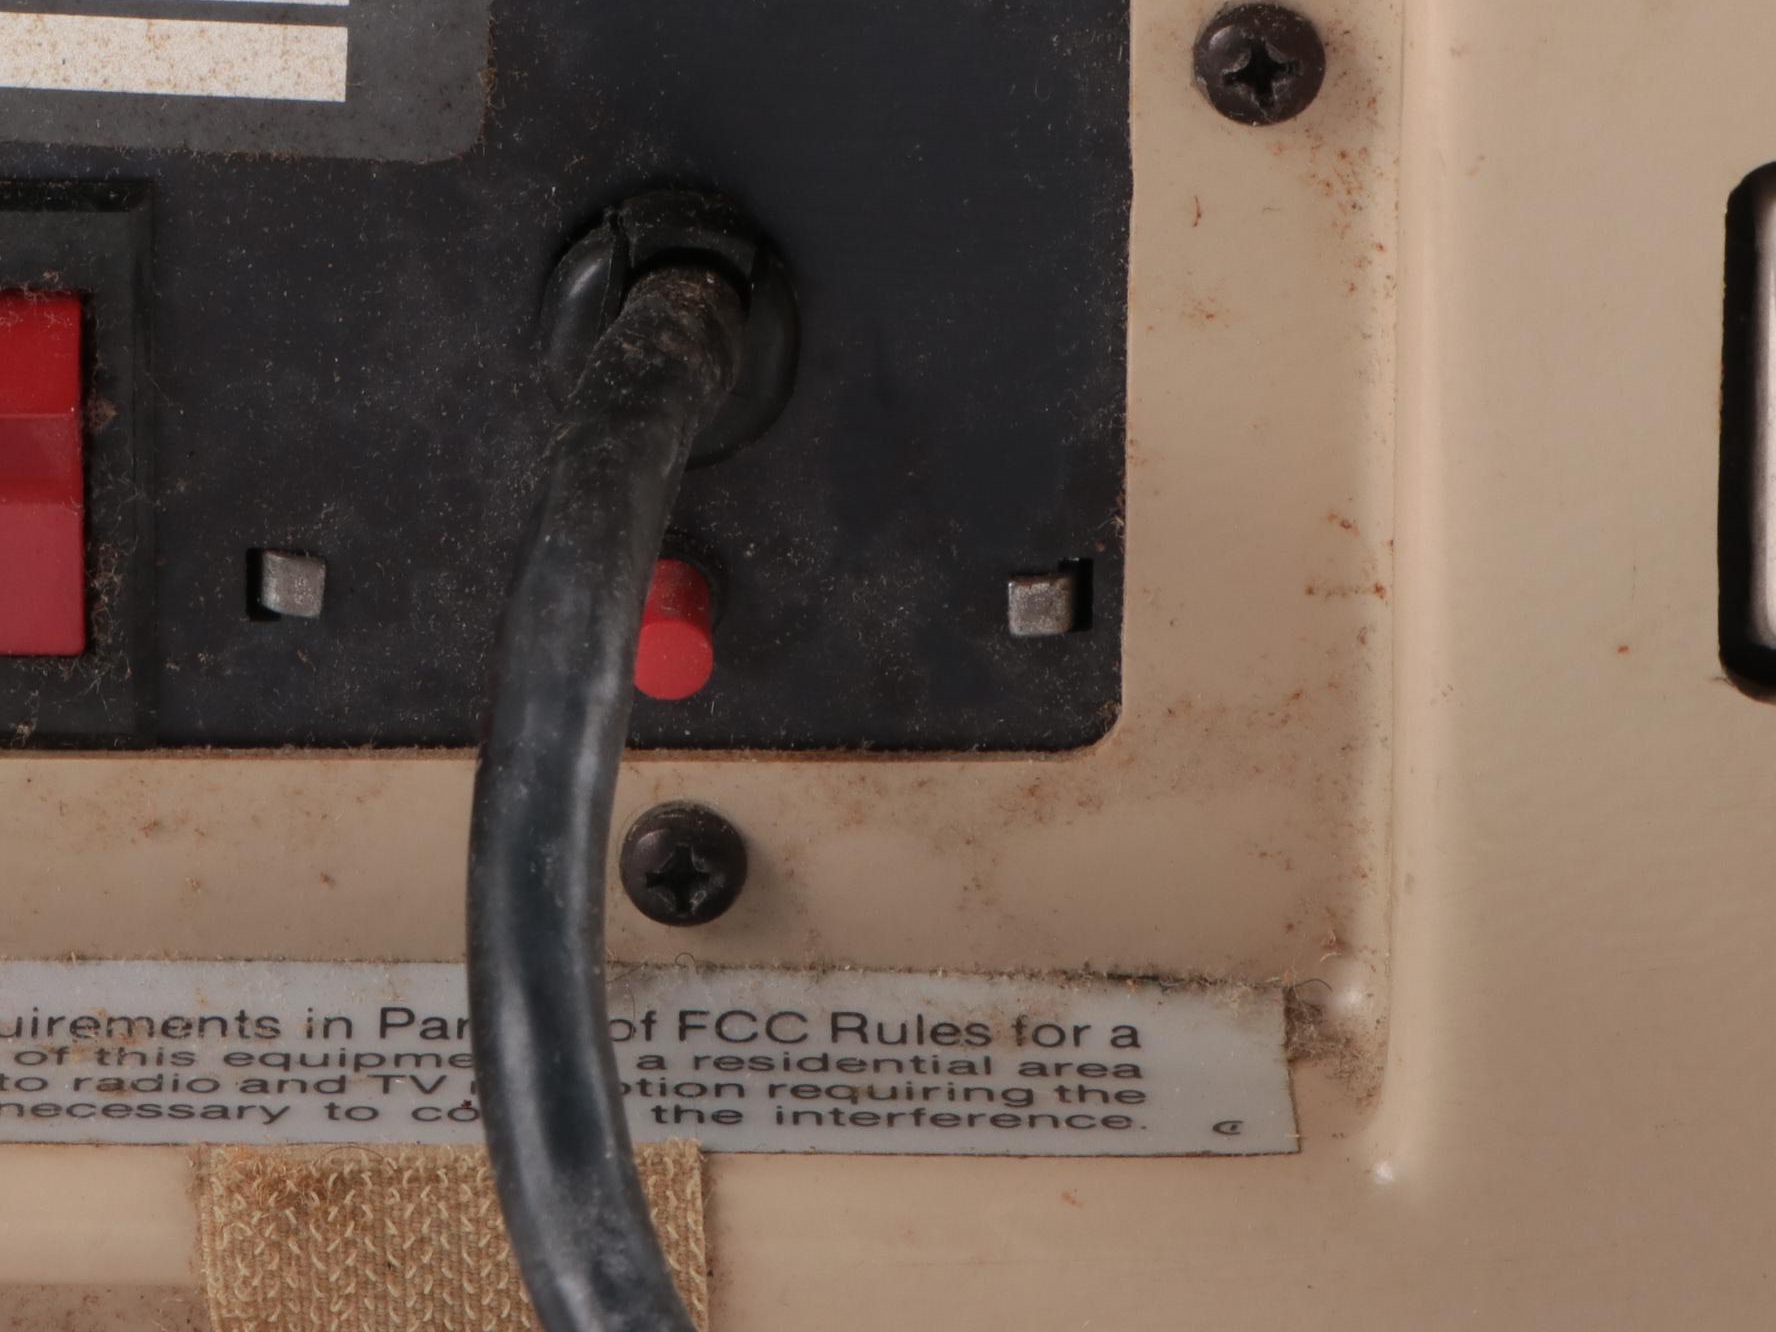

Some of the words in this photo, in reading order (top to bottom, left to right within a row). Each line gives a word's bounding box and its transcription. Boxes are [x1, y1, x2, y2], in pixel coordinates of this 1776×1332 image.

[305, 1006, 354, 1040] in
[379, 1006, 472, 1041] Par
[608, 1009, 659, 1042] of
[677, 1008, 808, 1044] FCC
[831, 1011, 993, 1049] Rules
[1012, 1015, 1092, 1049] for
[1109, 1023, 1142, 1050] a
[13, 1046, 70, 1066] of
[95, 1046, 196, 1067] this
[223, 1046, 475, 1072] equipme
[636, 1053, 667, 1072] a
[692, 1050, 992, 1076] residential
[1017, 1060, 1144, 1080] area
[72, 1072, 221, 1094] radio
[239, 1074, 347, 1095] and
[369, 1074, 448, 1095] TV
[768, 1079, 1035, 1108] requiring
[1054, 1083, 1147, 1105] the
[325, 1101, 380, 1122] to
[650, 1104, 744, 1126] the
[775, 1105, 1148, 1129] interference.
